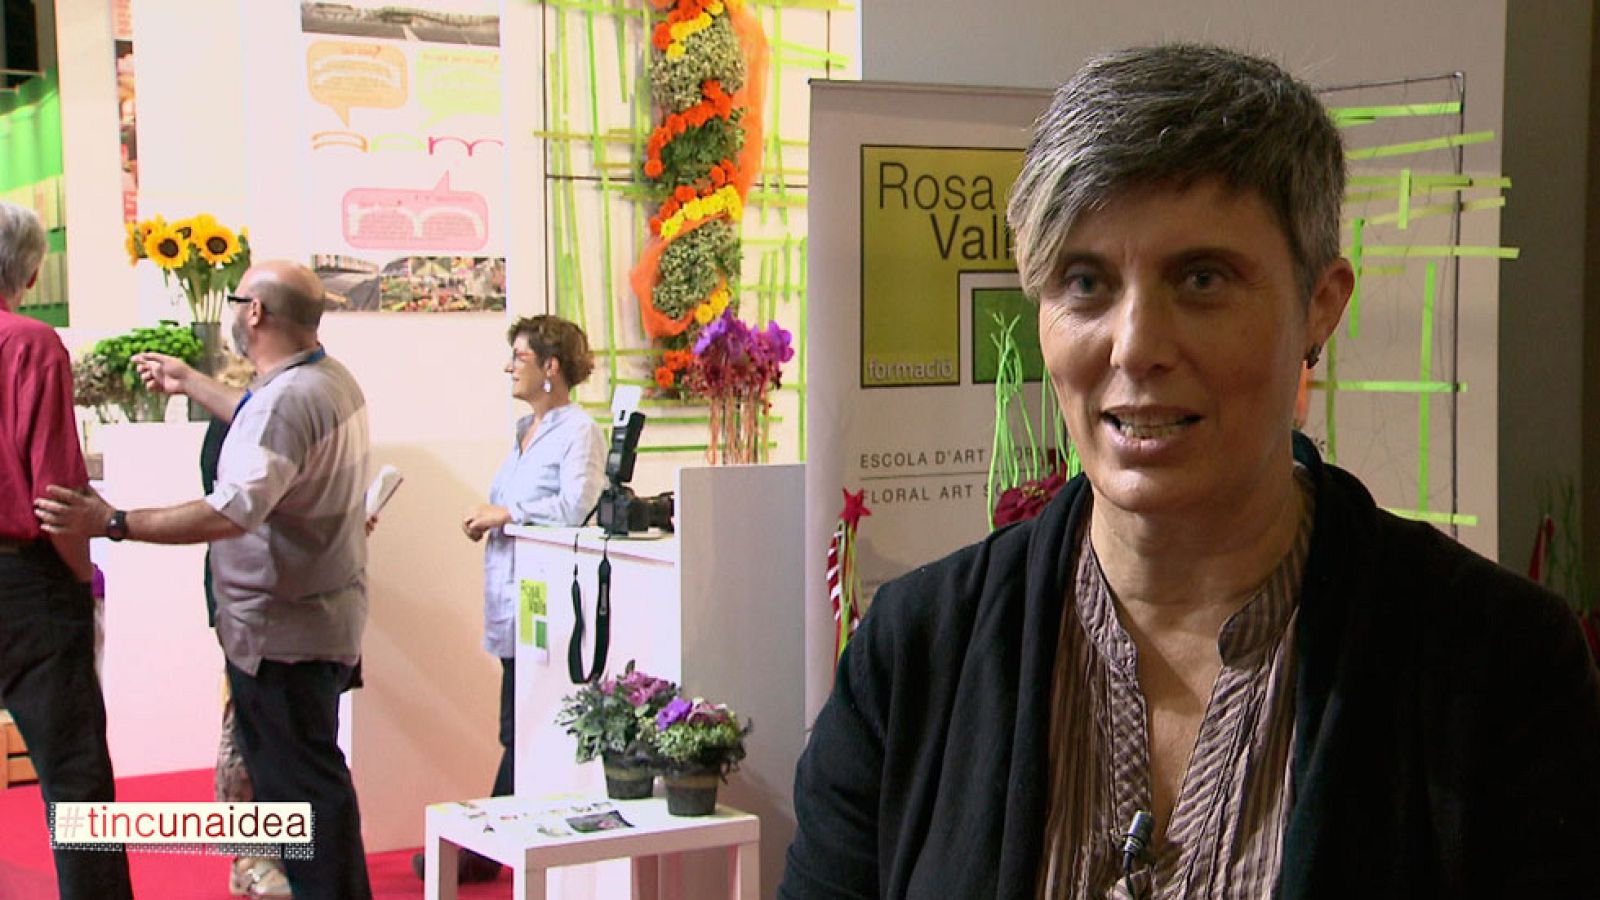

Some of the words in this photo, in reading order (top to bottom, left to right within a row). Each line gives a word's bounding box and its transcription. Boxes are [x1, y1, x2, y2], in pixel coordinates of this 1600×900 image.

[879, 161, 996, 211] Rosa
[930, 213, 1011, 261] Vall
[868, 357, 953, 380] formació
[860, 451, 928, 469] ESCOLA
[935, 448, 985, 465] D'ART
[939, 484, 973, 500] ART
